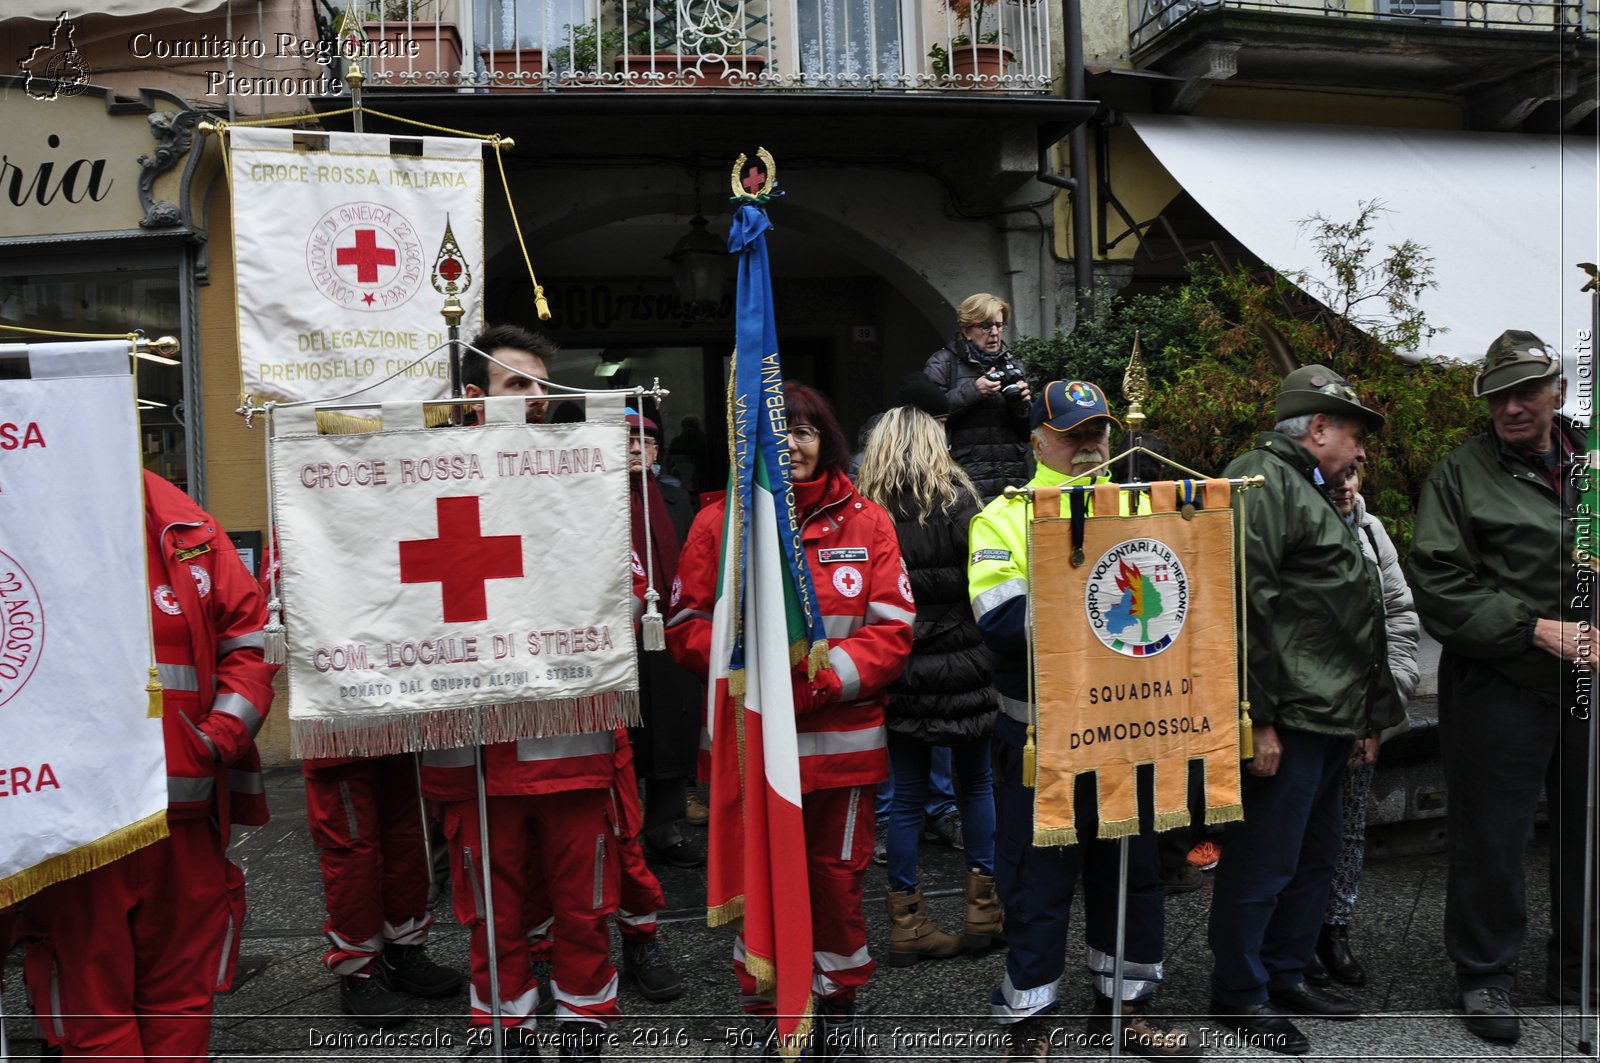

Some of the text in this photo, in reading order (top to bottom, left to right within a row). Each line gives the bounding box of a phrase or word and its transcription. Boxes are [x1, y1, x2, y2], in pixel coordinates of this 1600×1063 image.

[0, 134, 113, 207] ria
[251, 164, 468, 189] CROCE ROSSA ITALIANA
[323, 217, 339, 232] DI
[340, 206, 391, 227] GINEVRA
[393, 222, 412, 239] 22
[402, 241, 420, 285] AGOSTO
[381, 286, 407, 307] 1864
[298, 330, 443, 351] DELEGAZIONE DI
[259, 358, 450, 381] PREMOSELLO CHIOVE
[761, 353, 790, 446] VERBANIA
[300, 447, 606, 489] CROCE ROSSA ITALIANA
[777, 449, 791, 467] DI
[1093, 541, 1150, 581] VOLONTARI
[791, 535, 813, 629] COMITATO
[1170, 562, 1187, 624] PIEMONTE
[1088, 583, 1104, 629] CORPO
[0, 601, 34, 679] AGOSTO
[313, 626, 614, 673] COM. LOCALE DI STRESA
[340, 682, 392, 698] DONATO
[400, 680, 424, 696] DAL
[431, 676, 481, 693] GRUPPO
[488, 670, 529, 688] ALPINI
[546, 667, 593, 683] STRESA
[1089, 678, 1193, 705] SQUADRA DI
[1070, 716, 1211, 749] DOMODOSSOLA
